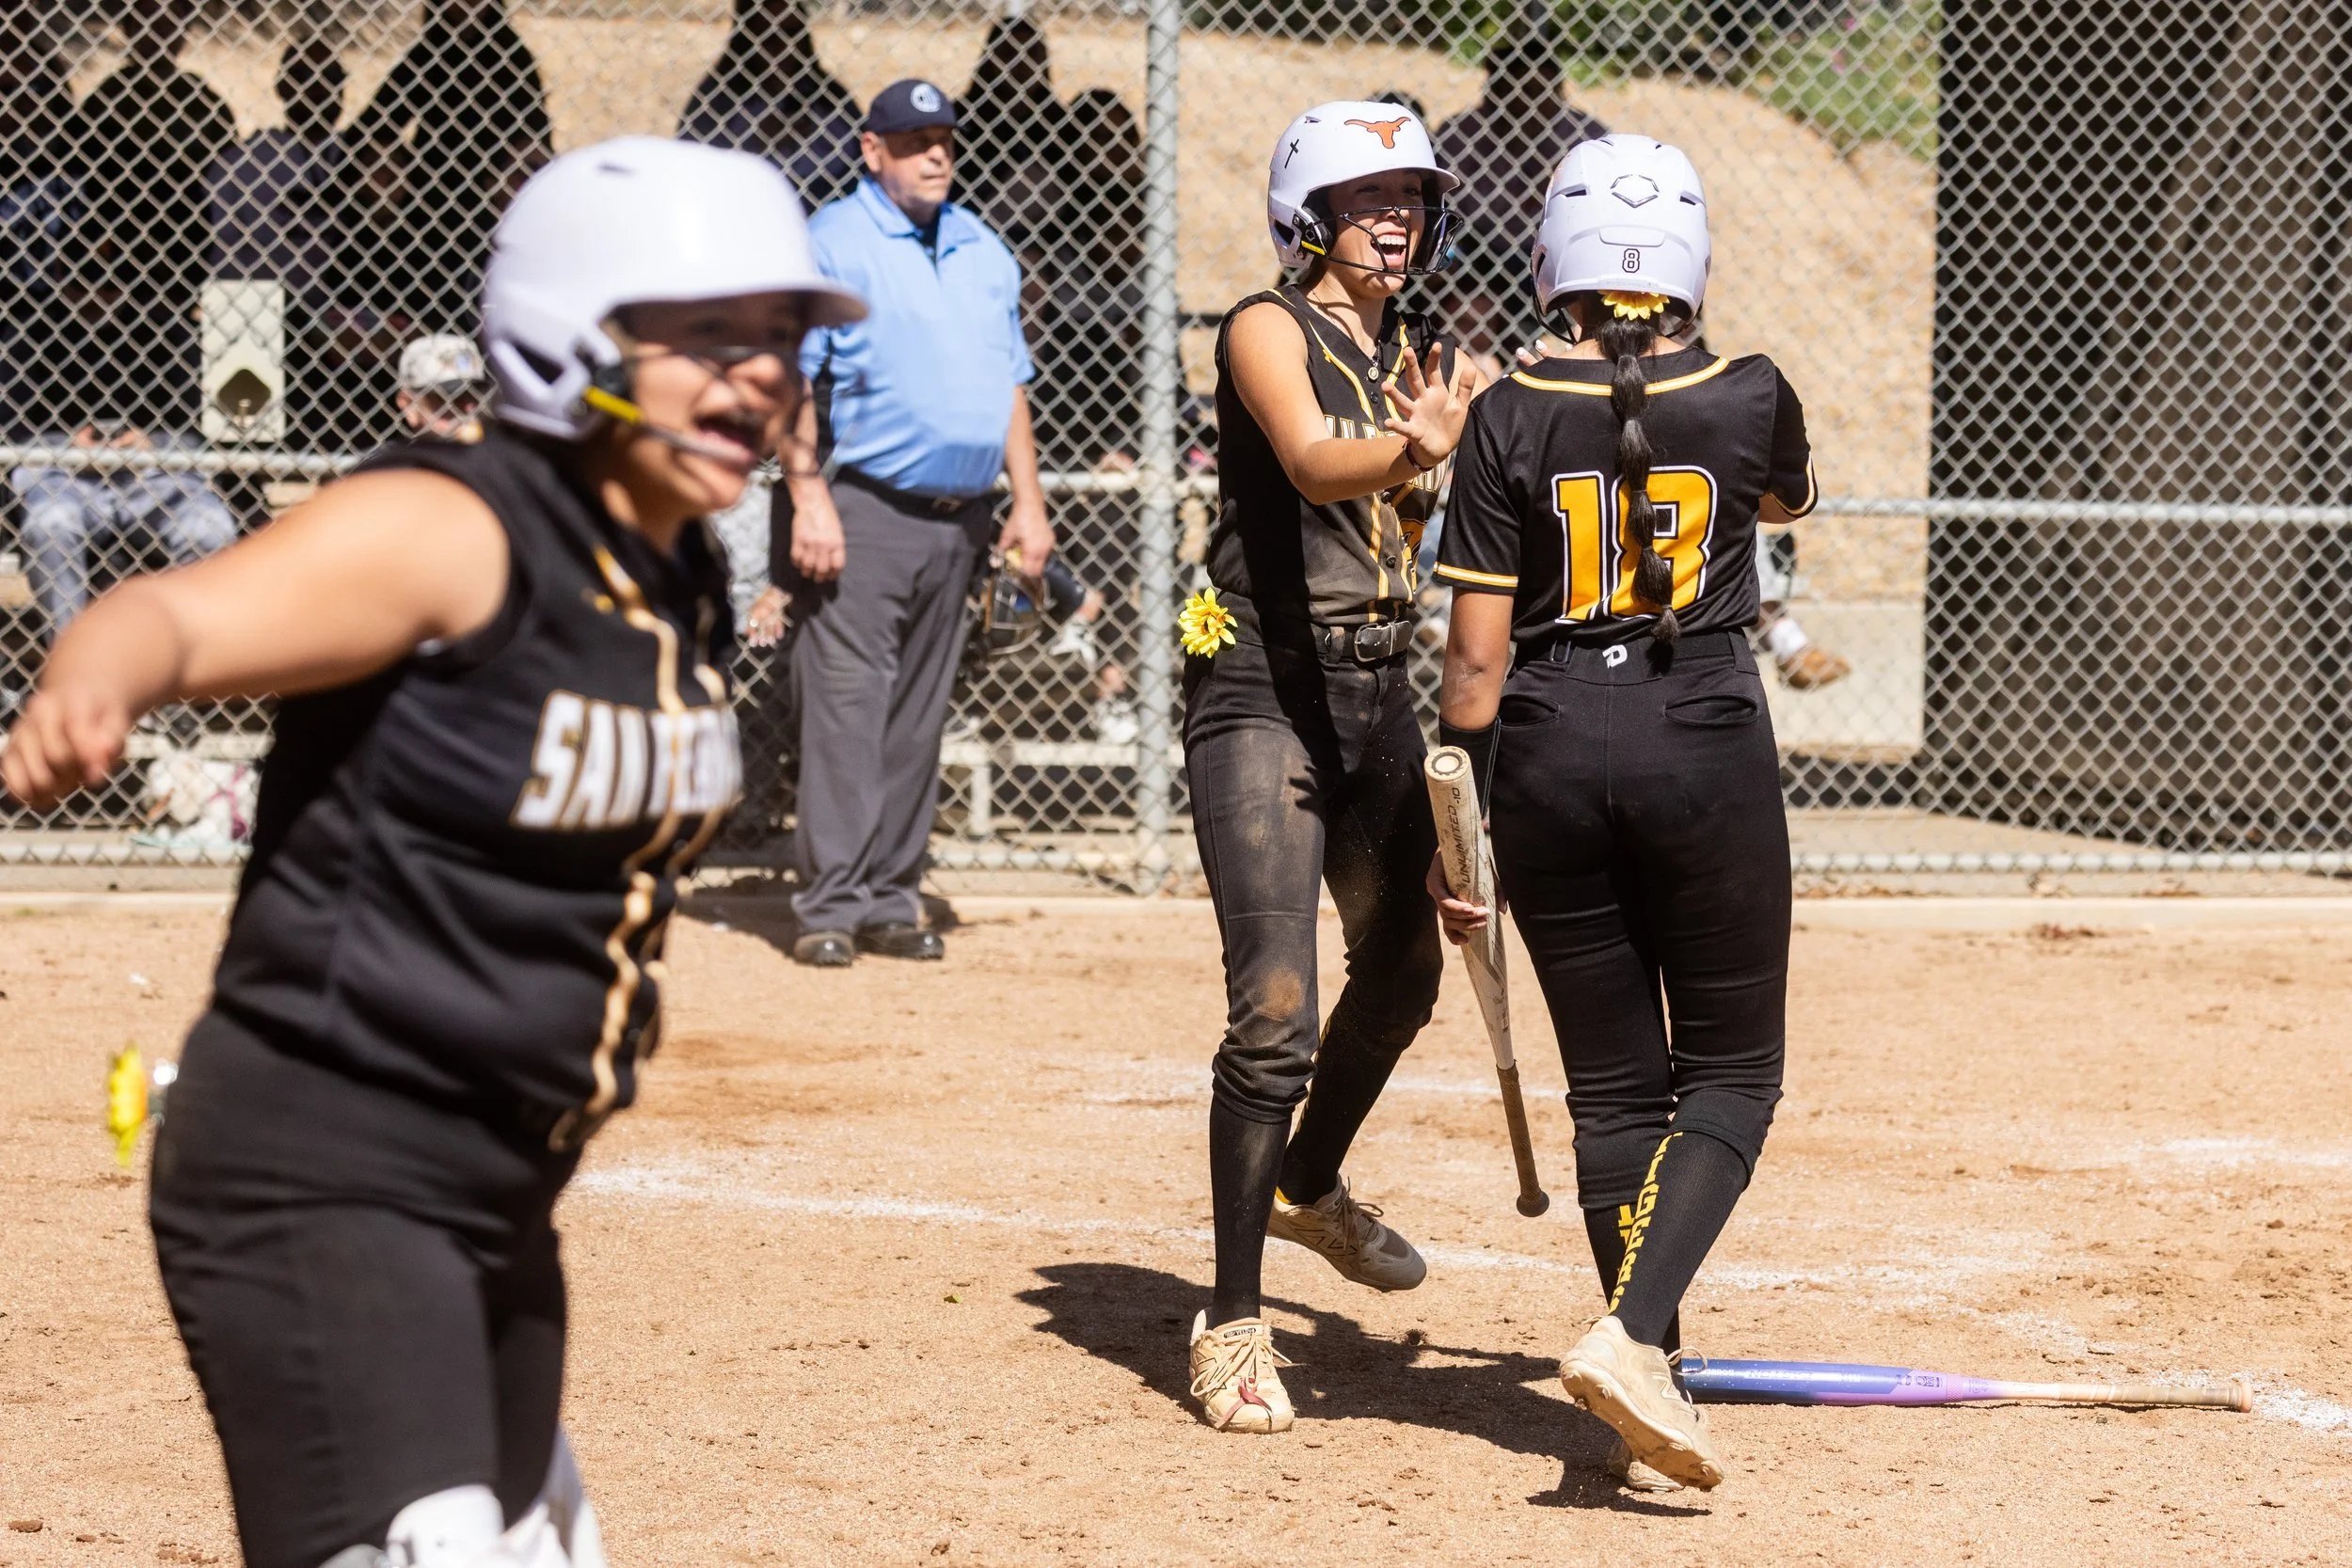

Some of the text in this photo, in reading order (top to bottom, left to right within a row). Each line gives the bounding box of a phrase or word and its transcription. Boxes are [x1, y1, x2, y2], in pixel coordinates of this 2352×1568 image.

[1621, 248, 1640, 273] 8
[1551, 466, 1717, 625] 18
[1448, 805, 1470, 883] UNLIMITED
